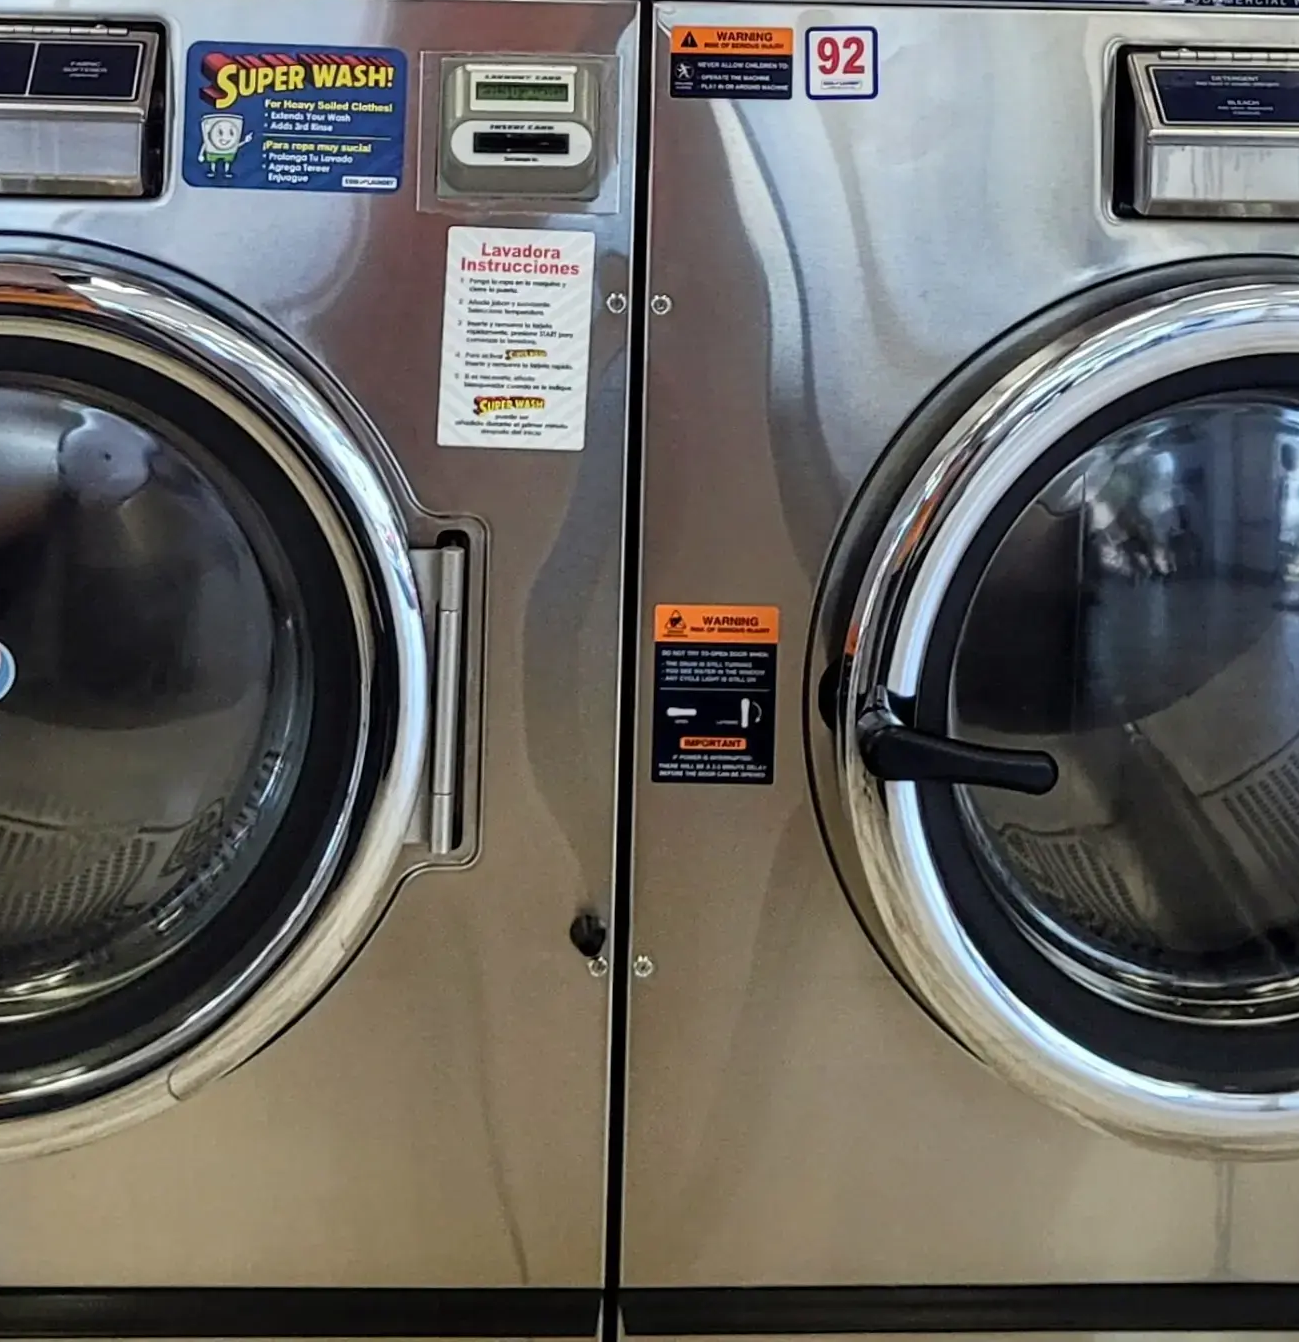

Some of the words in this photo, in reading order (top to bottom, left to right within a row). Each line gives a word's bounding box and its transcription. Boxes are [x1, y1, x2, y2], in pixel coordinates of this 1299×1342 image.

[717, 31, 774, 42] WARNING
[816, 36, 866, 76] 92
[209, 59, 306, 109] SUPER
[309, 59, 395, 89] WASH!
[264, 99, 281, 109] For
[283, 100, 315, 111] Heavy
[317, 101, 349, 112] Soiled
[351, 102, 393, 113] Clothes!
[270, 111, 303, 121] Extends
[306, 112, 326, 121] Your
[327, 113, 352, 123] Wash
[270, 122, 293, 131] Adds
[310, 123, 334, 132] Rinse
[316, 144, 339, 154] muy
[481, 242, 561, 260] Lavadora
[460, 257, 580, 276] Instrucciones
[702, 615, 759, 627] WARNING
[684, 739, 742, 748] IMPORTANT
